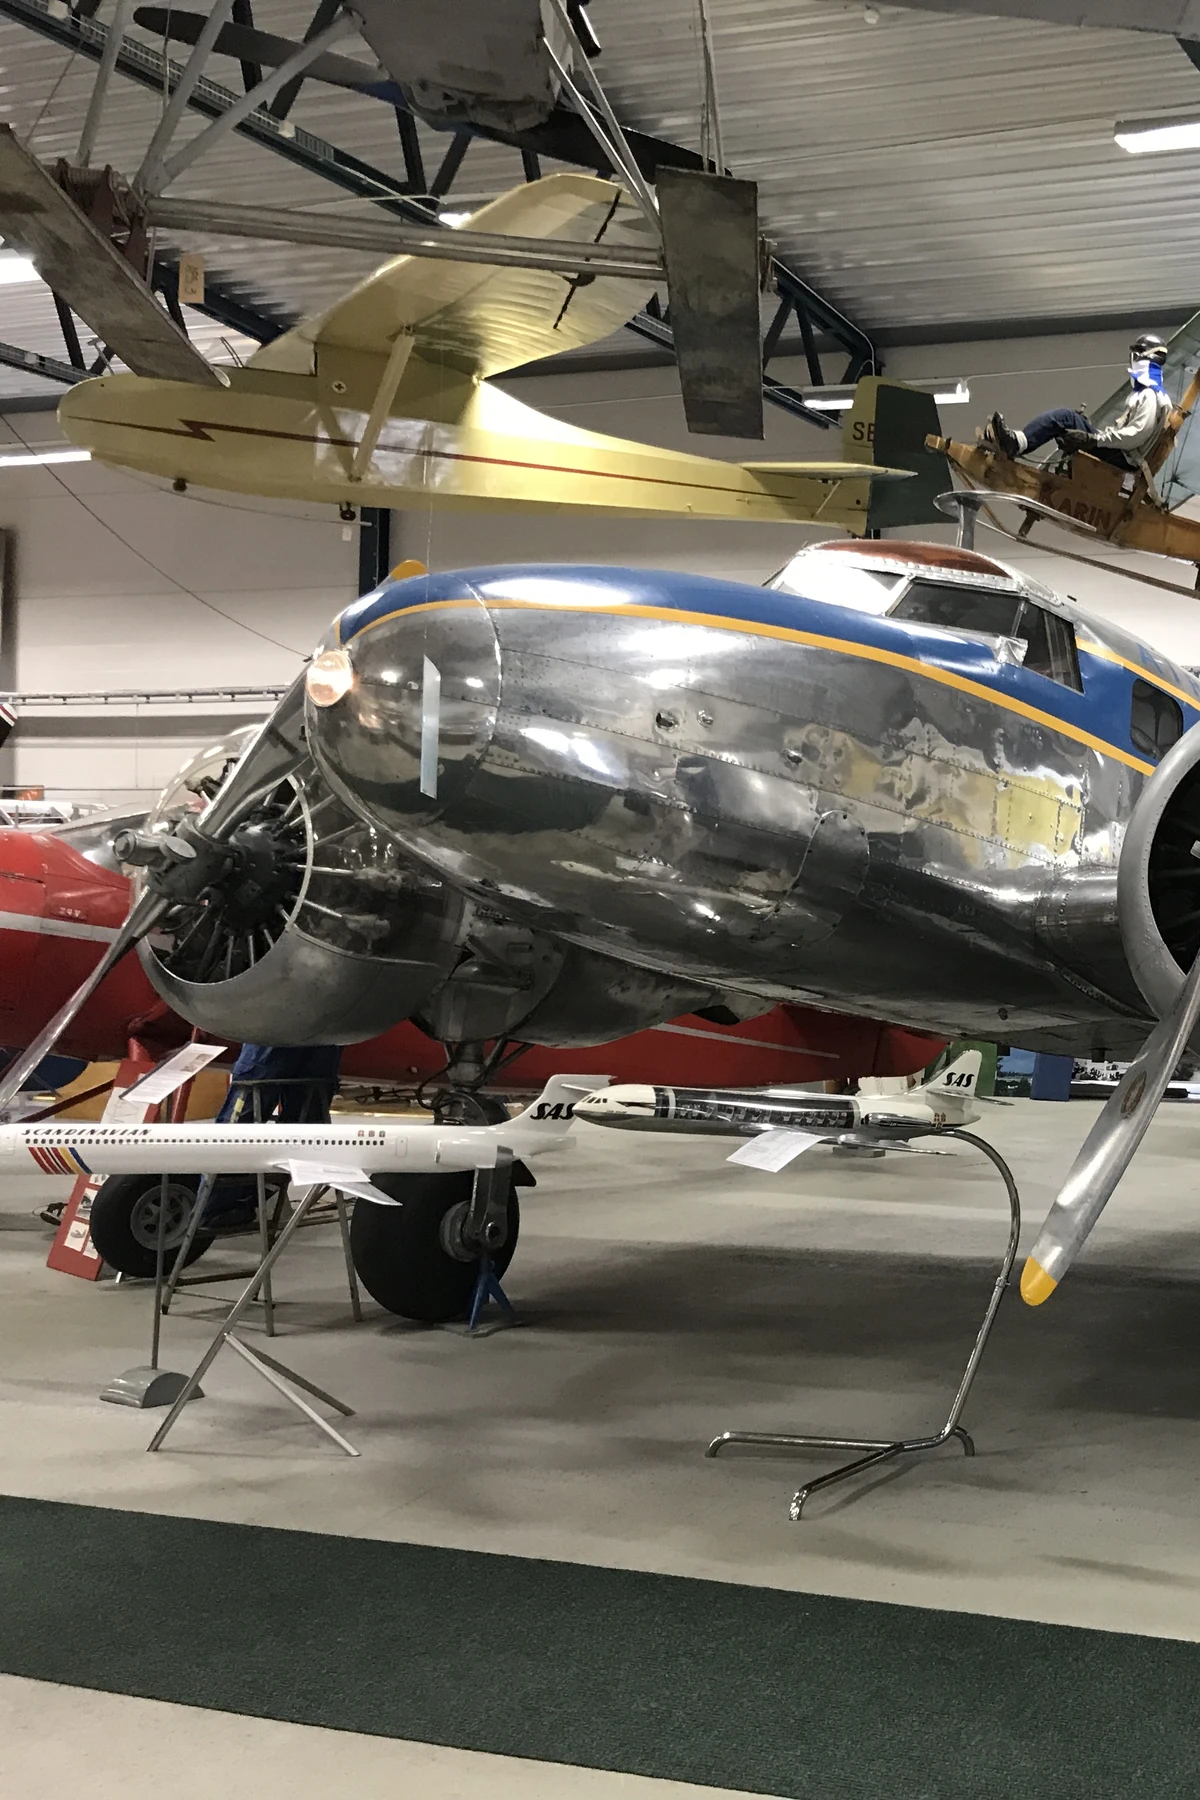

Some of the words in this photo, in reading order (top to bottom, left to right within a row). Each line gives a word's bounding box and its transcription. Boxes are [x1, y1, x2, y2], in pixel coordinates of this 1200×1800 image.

[1039, 481, 1112, 530] KARIN
[943, 1072, 975, 1088] SAS
[529, 1103, 577, 1120] SAS
[21, 1128, 152, 1136] SCANDINAVIAN
